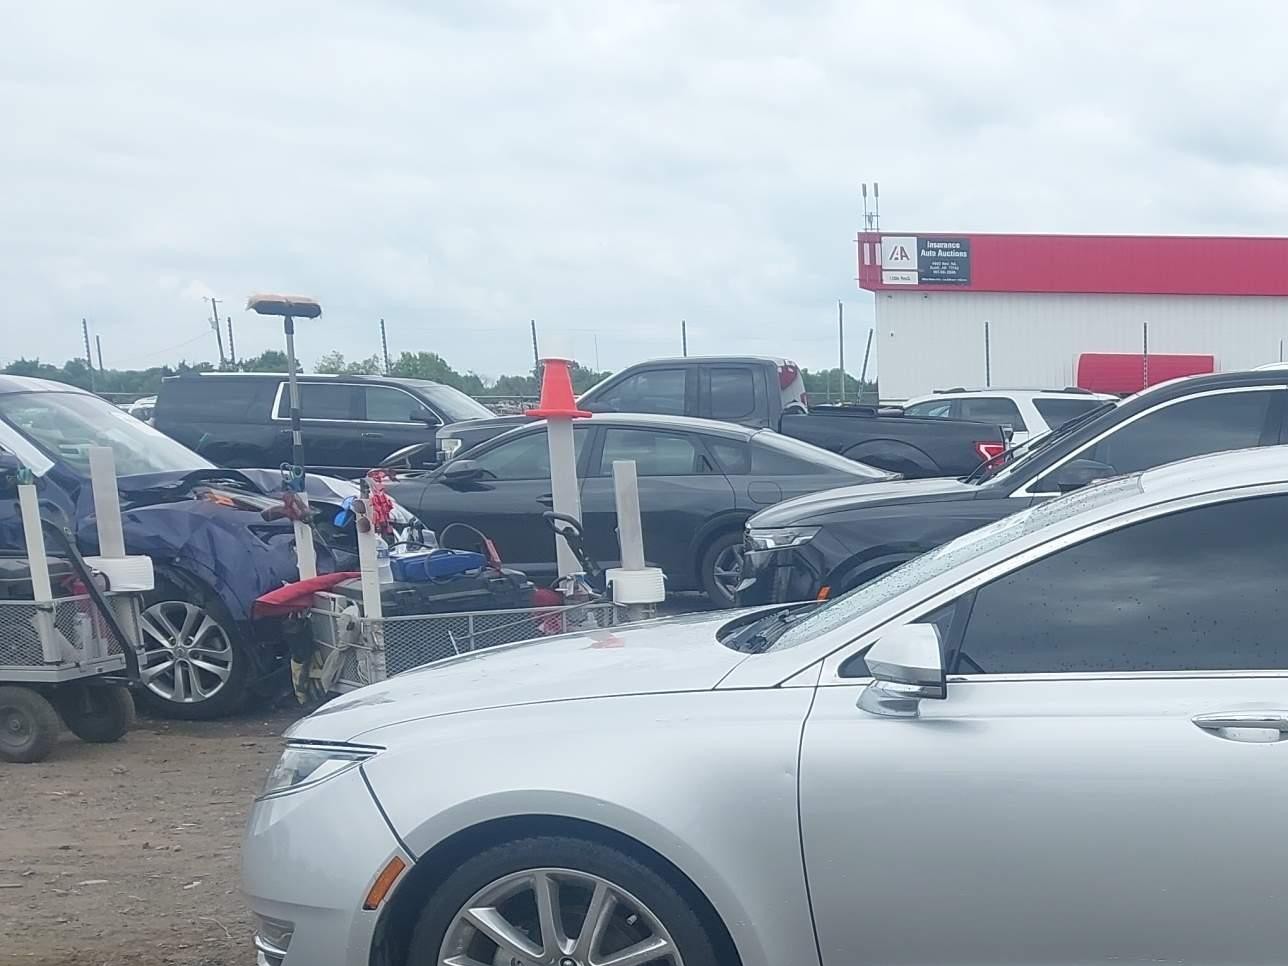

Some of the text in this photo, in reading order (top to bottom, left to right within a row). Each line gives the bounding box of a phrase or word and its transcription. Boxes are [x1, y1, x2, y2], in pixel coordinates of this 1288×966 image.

[927, 241, 961, 249] Insurance
[920, 249, 968, 258] Auto Auctions
